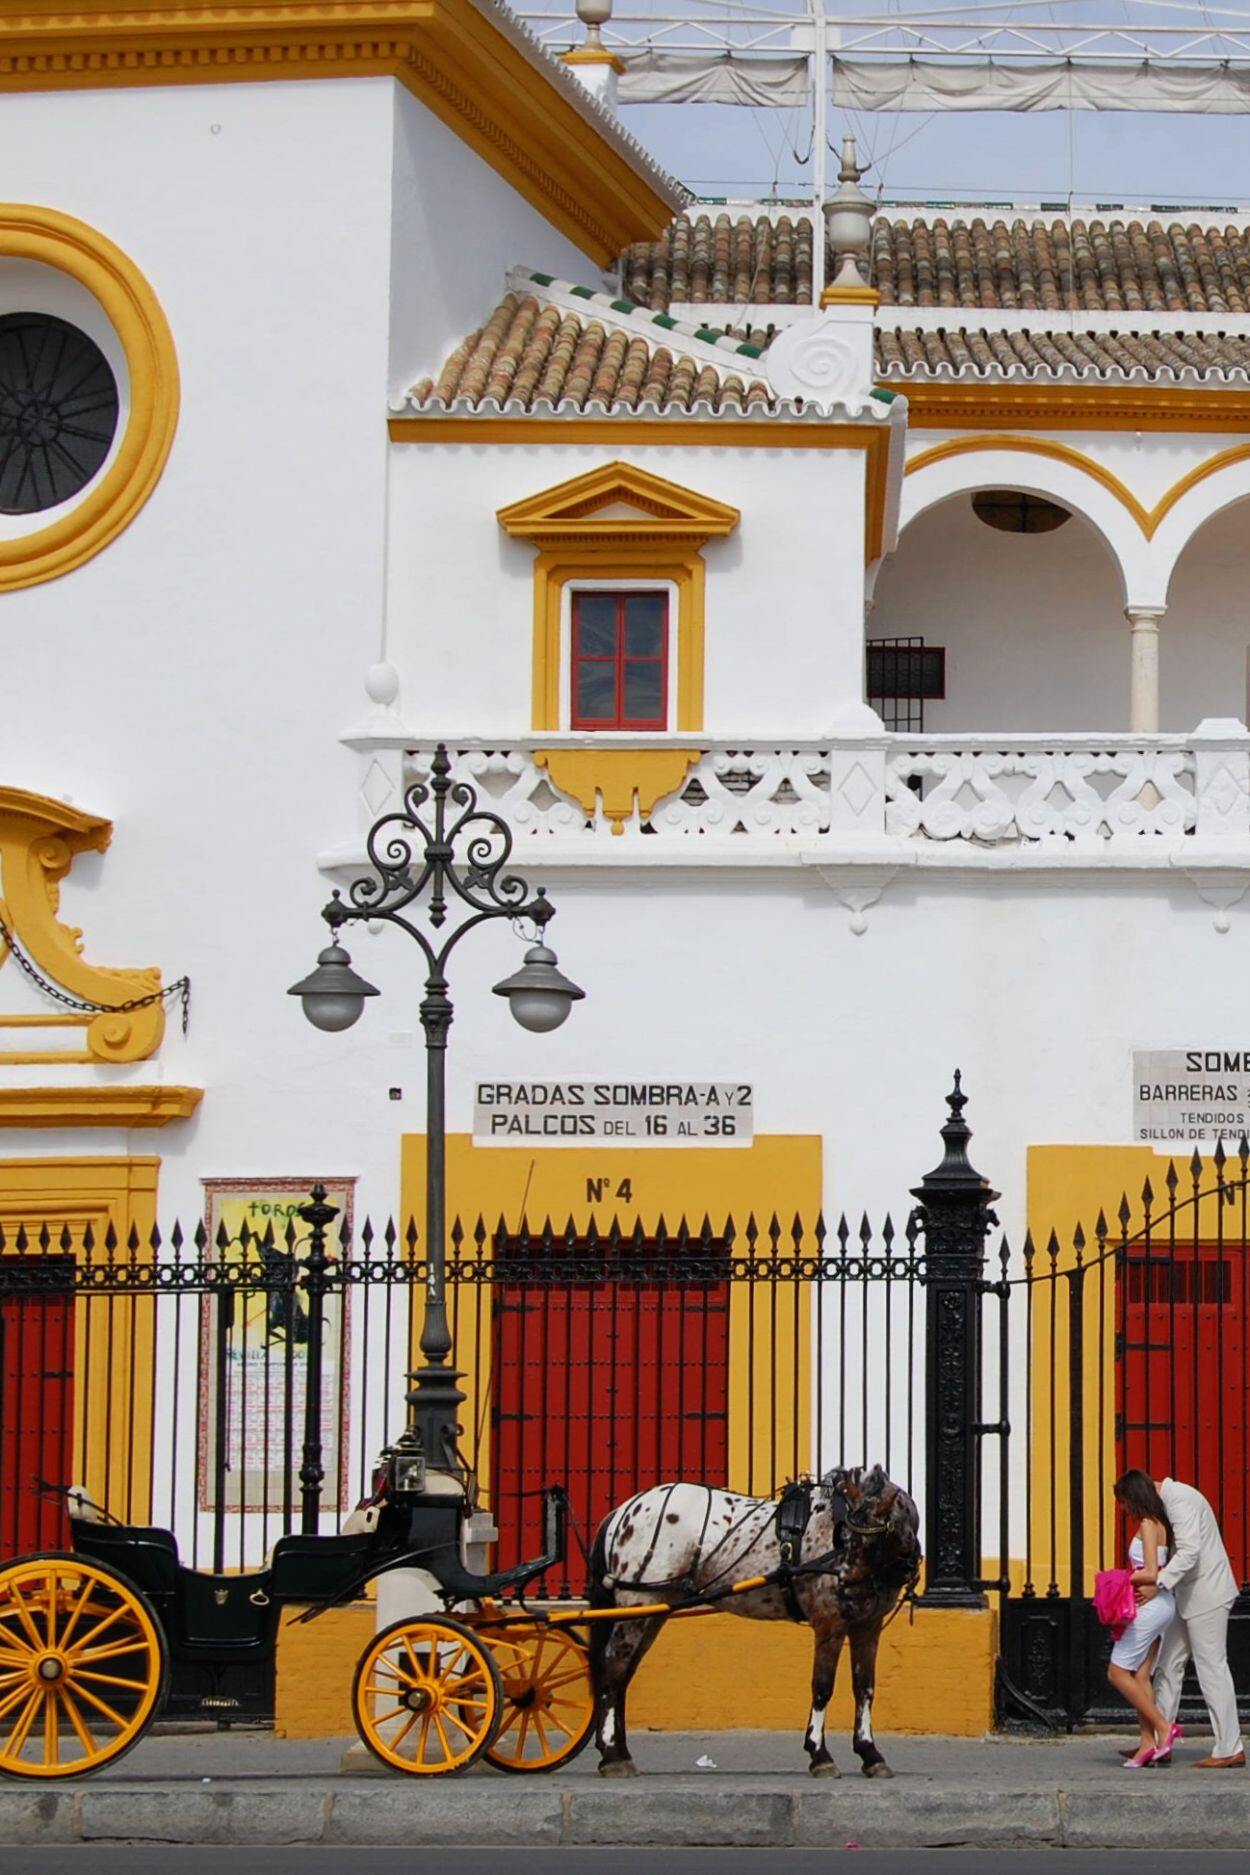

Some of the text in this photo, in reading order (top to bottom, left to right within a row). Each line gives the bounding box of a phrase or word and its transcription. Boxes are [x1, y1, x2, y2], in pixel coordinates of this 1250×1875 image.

[477, 1084, 584, 1106] GRADAS
[725, 1091, 734, 1106] Y
[737, 1085, 752, 1106] 2
[1139, 1085, 1238, 1101] BARRERAS
[491, 1114, 736, 1136] PALCOS DEL 16 AL 36
[1180, 1113, 1244, 1124] TENDIDOS
[1139, 1129, 1184, 1140] SILLON
[1188, 1129, 1206, 1140] DE
[615, 1177, 632, 1203] 4
